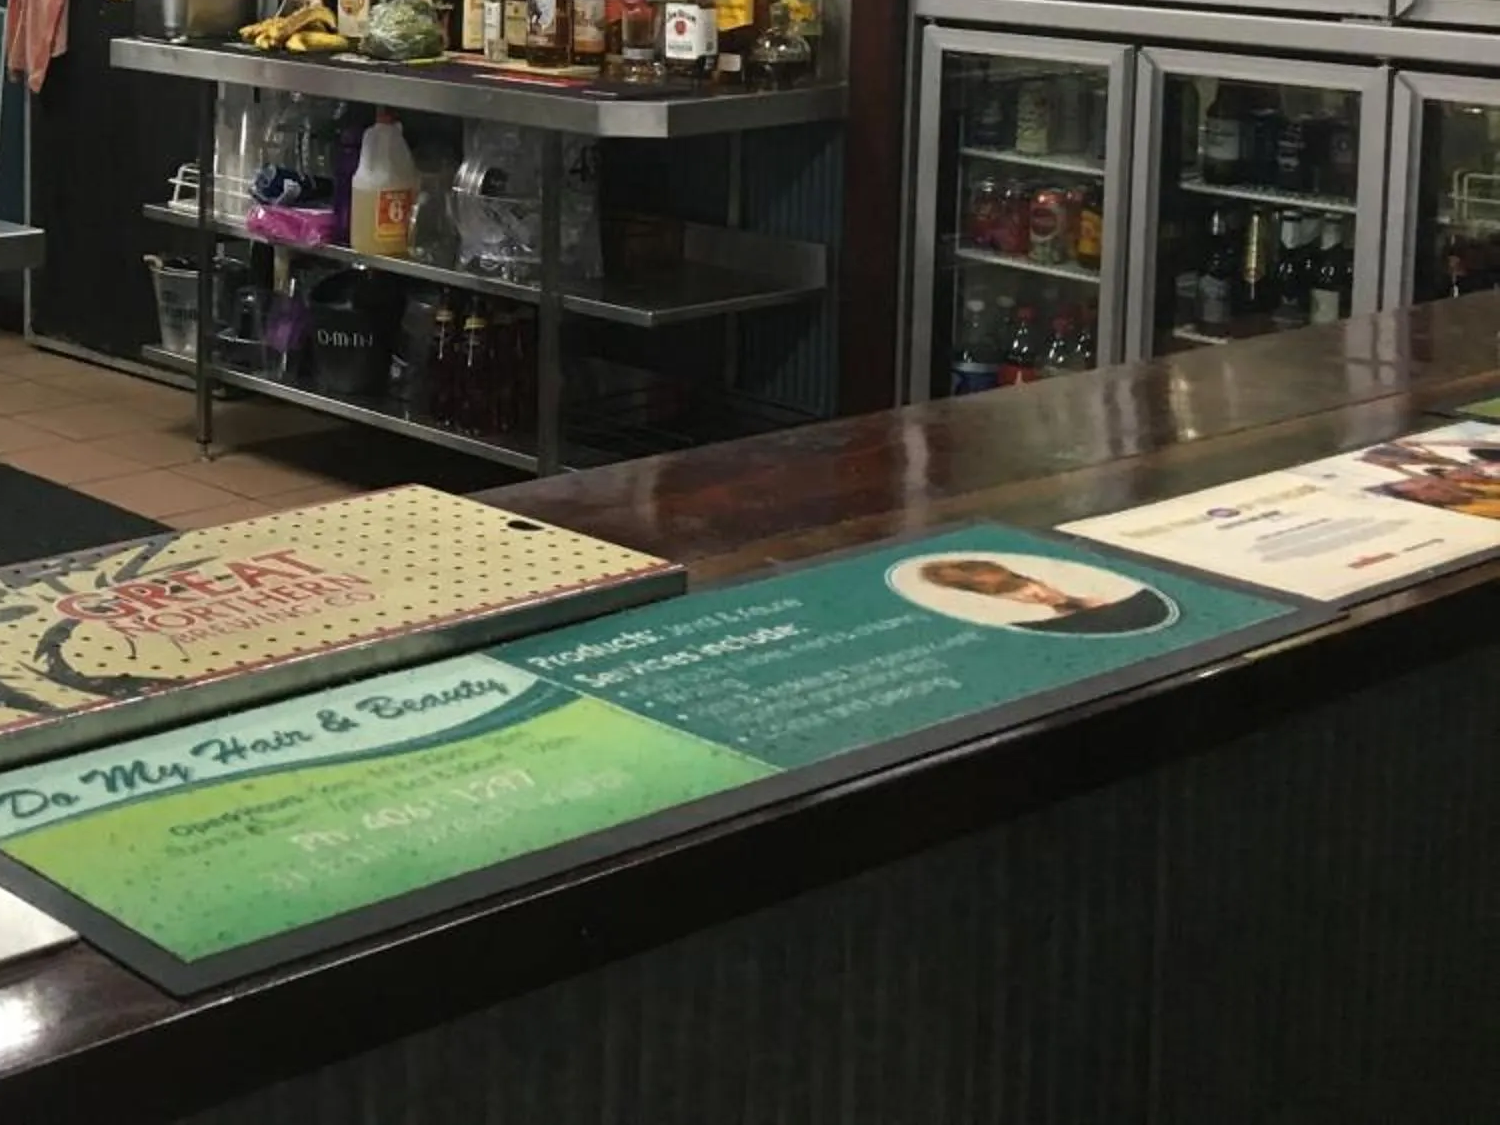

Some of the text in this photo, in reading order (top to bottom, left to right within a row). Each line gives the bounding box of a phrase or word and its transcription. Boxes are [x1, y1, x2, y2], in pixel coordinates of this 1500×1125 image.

[57, 549, 325, 620] GREAT
[110, 572, 373, 636] NORTHERN
[527, 627, 666, 672] Products:
[79, 759, 195, 797] My
[189, 726, 316, 765] Hair
[315, 709, 359, 733] &
[355, 676, 510, 721] Beauty
